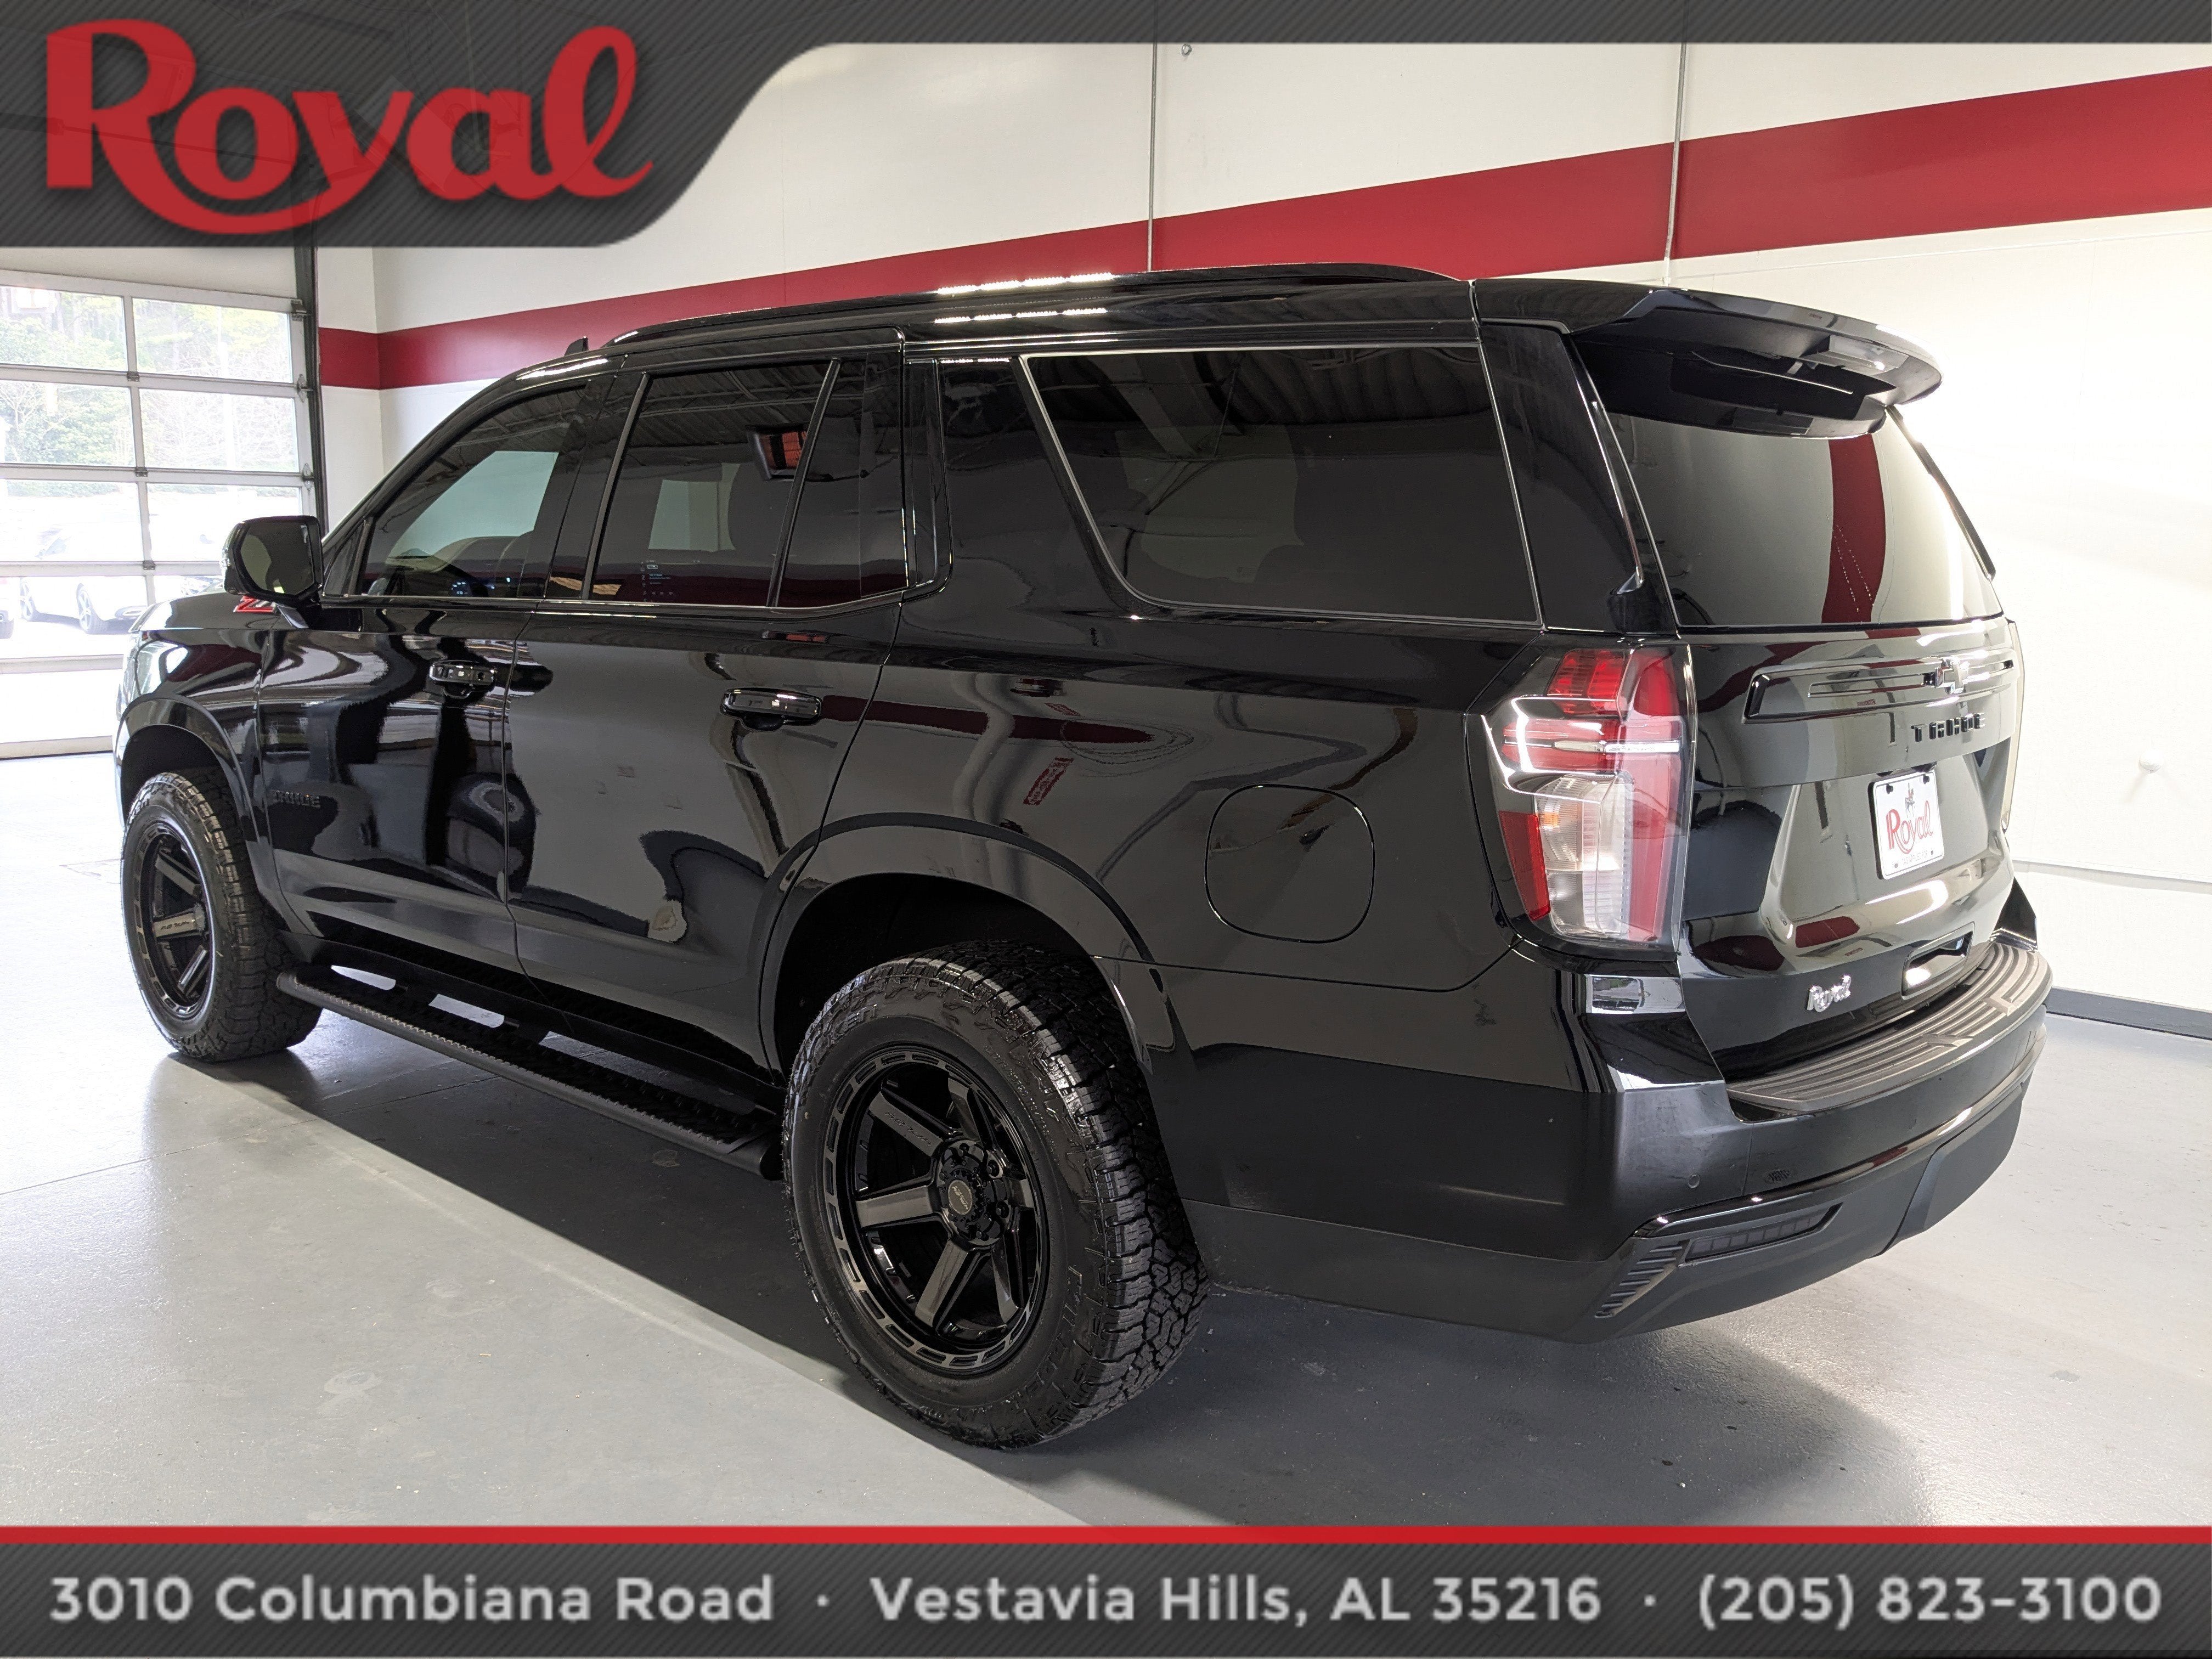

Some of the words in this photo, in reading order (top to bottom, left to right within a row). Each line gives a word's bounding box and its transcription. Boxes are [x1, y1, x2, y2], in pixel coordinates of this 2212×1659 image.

[1911, 712, 1986, 742] TAHOE
[1886, 800, 1934, 855] Royal
[1807, 974, 1852, 1013] Royal
